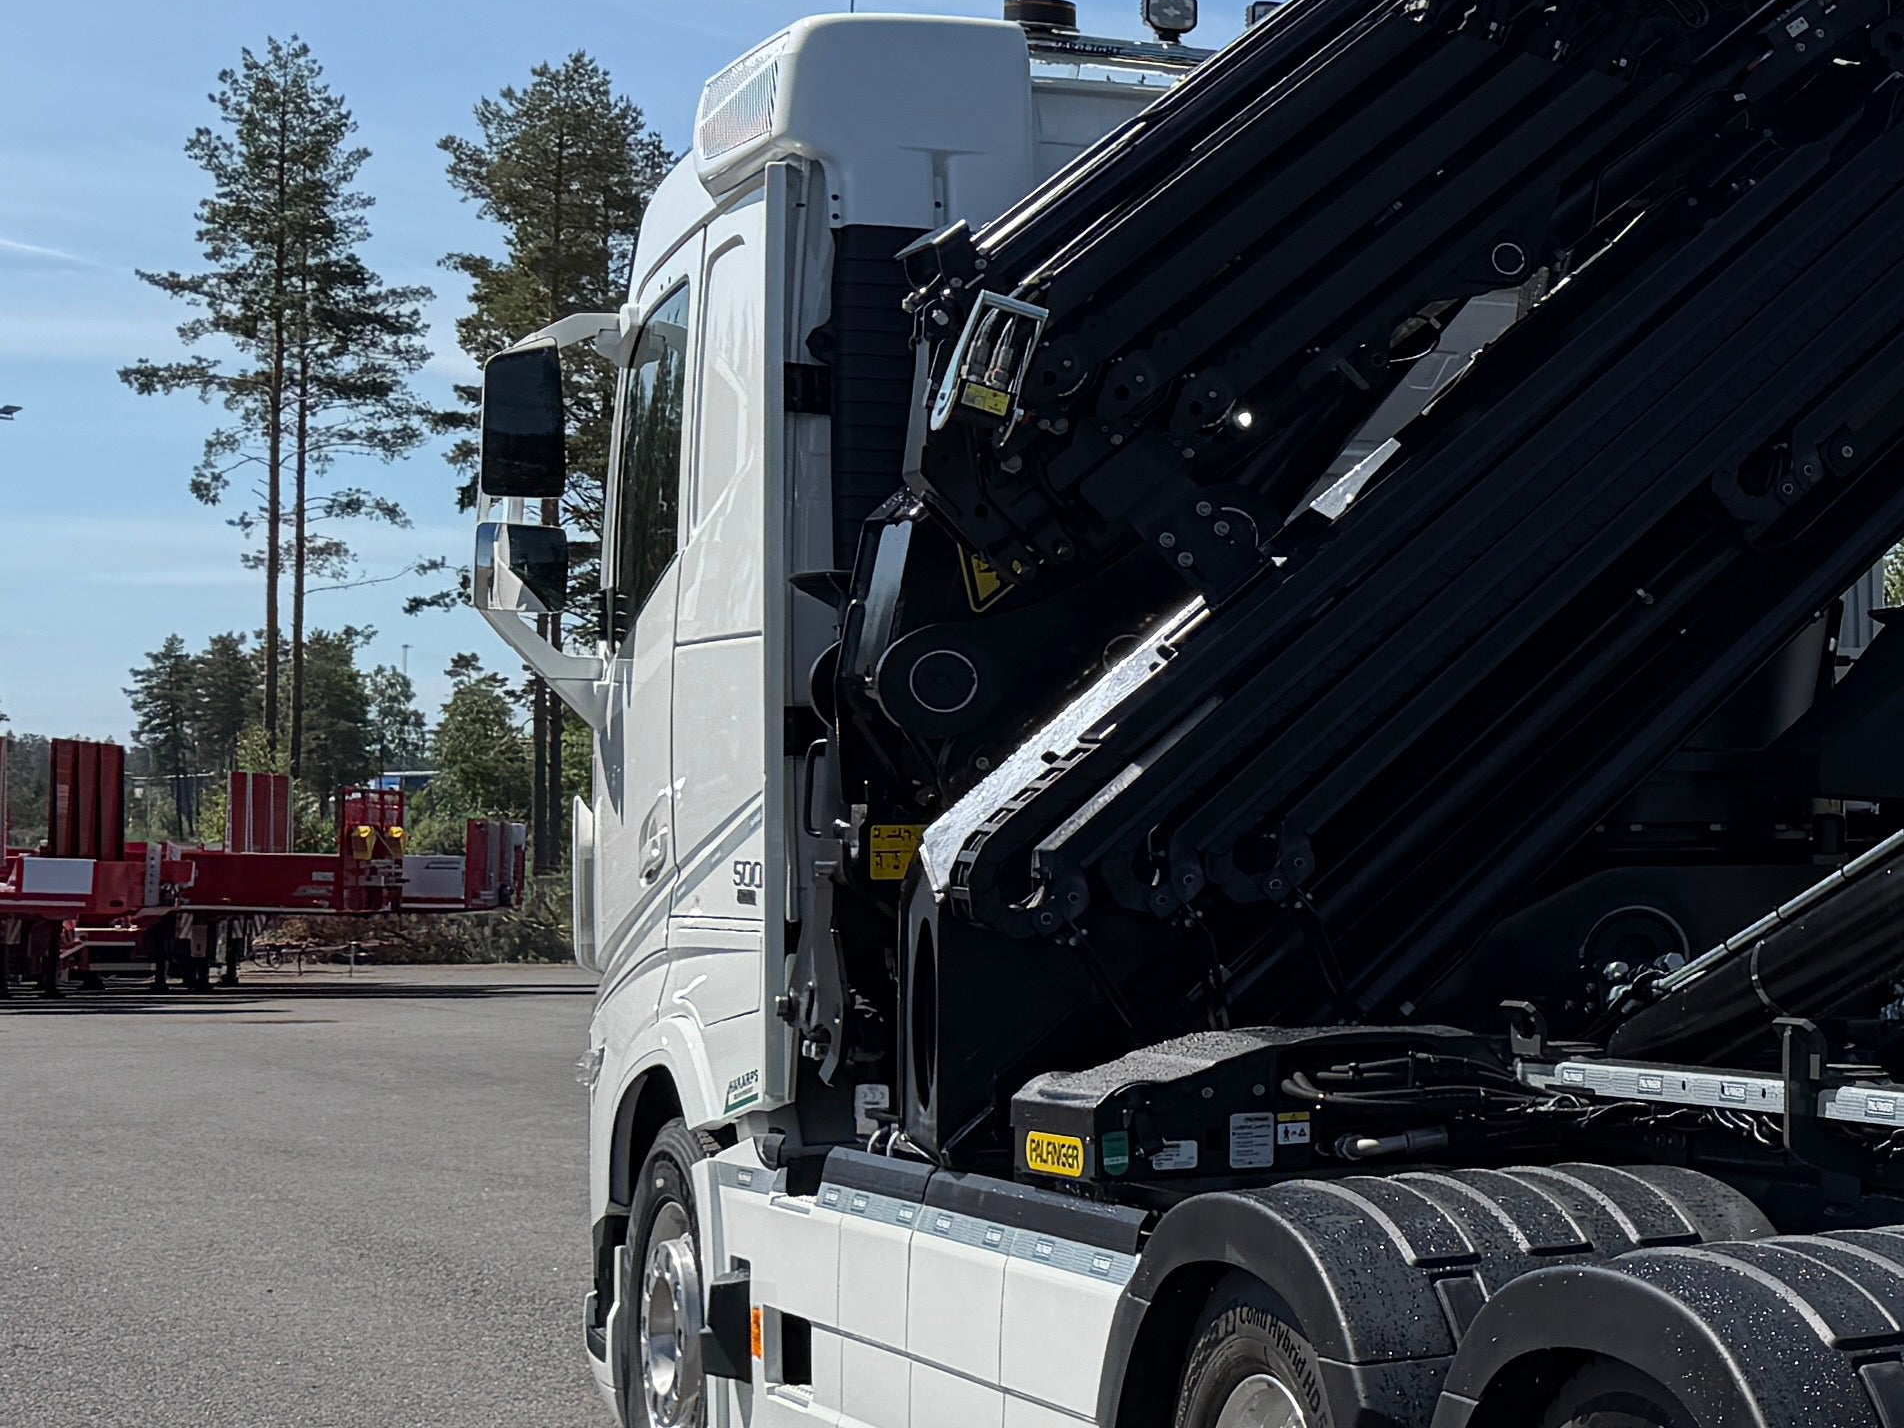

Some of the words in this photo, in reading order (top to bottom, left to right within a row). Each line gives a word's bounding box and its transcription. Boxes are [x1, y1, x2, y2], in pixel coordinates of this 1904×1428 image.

[733, 860, 763, 888] 500
[1028, 1137, 1081, 1170] PALFINGER
[1268, 1314, 1307, 1378] Hybrid
